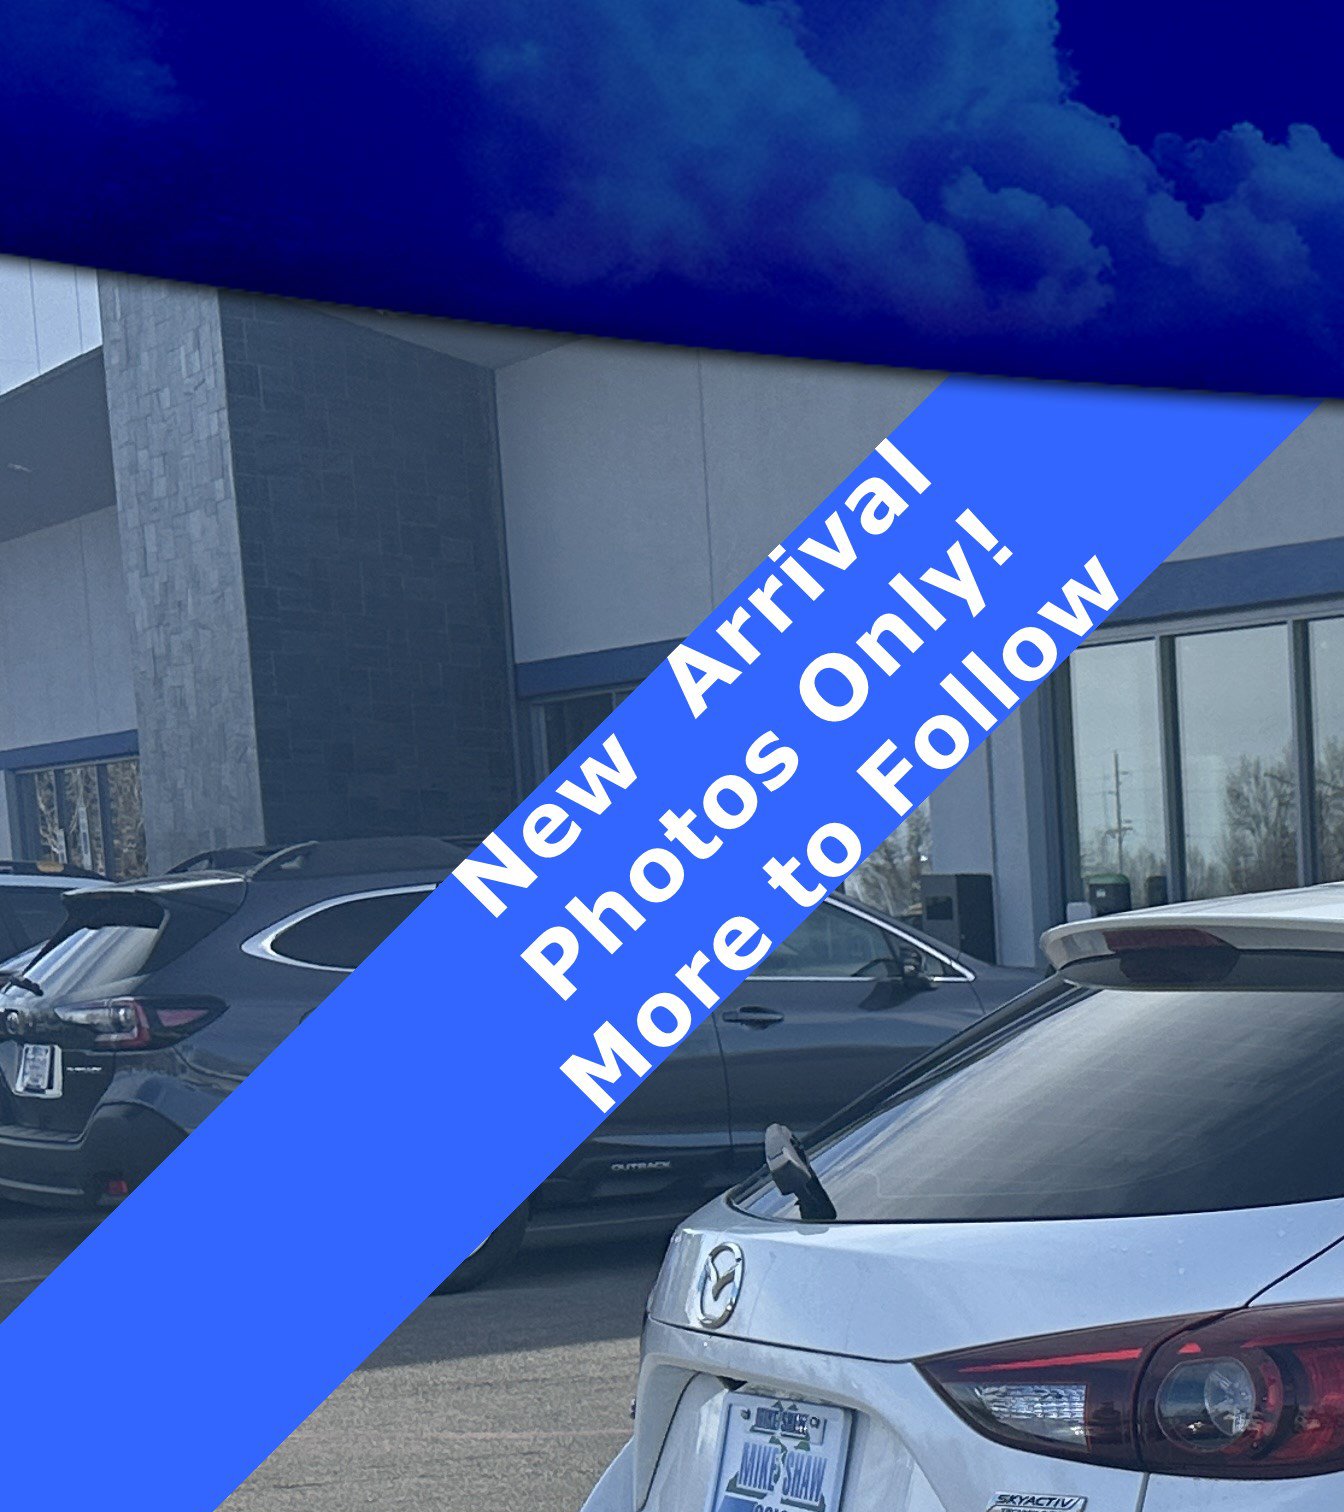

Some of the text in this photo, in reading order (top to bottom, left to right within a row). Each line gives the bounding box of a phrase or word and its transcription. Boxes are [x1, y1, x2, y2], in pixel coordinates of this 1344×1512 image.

[737, 1441, 828, 1503] MIKE SHAW
[996, 1494, 1075, 1508] SKYACTIV
